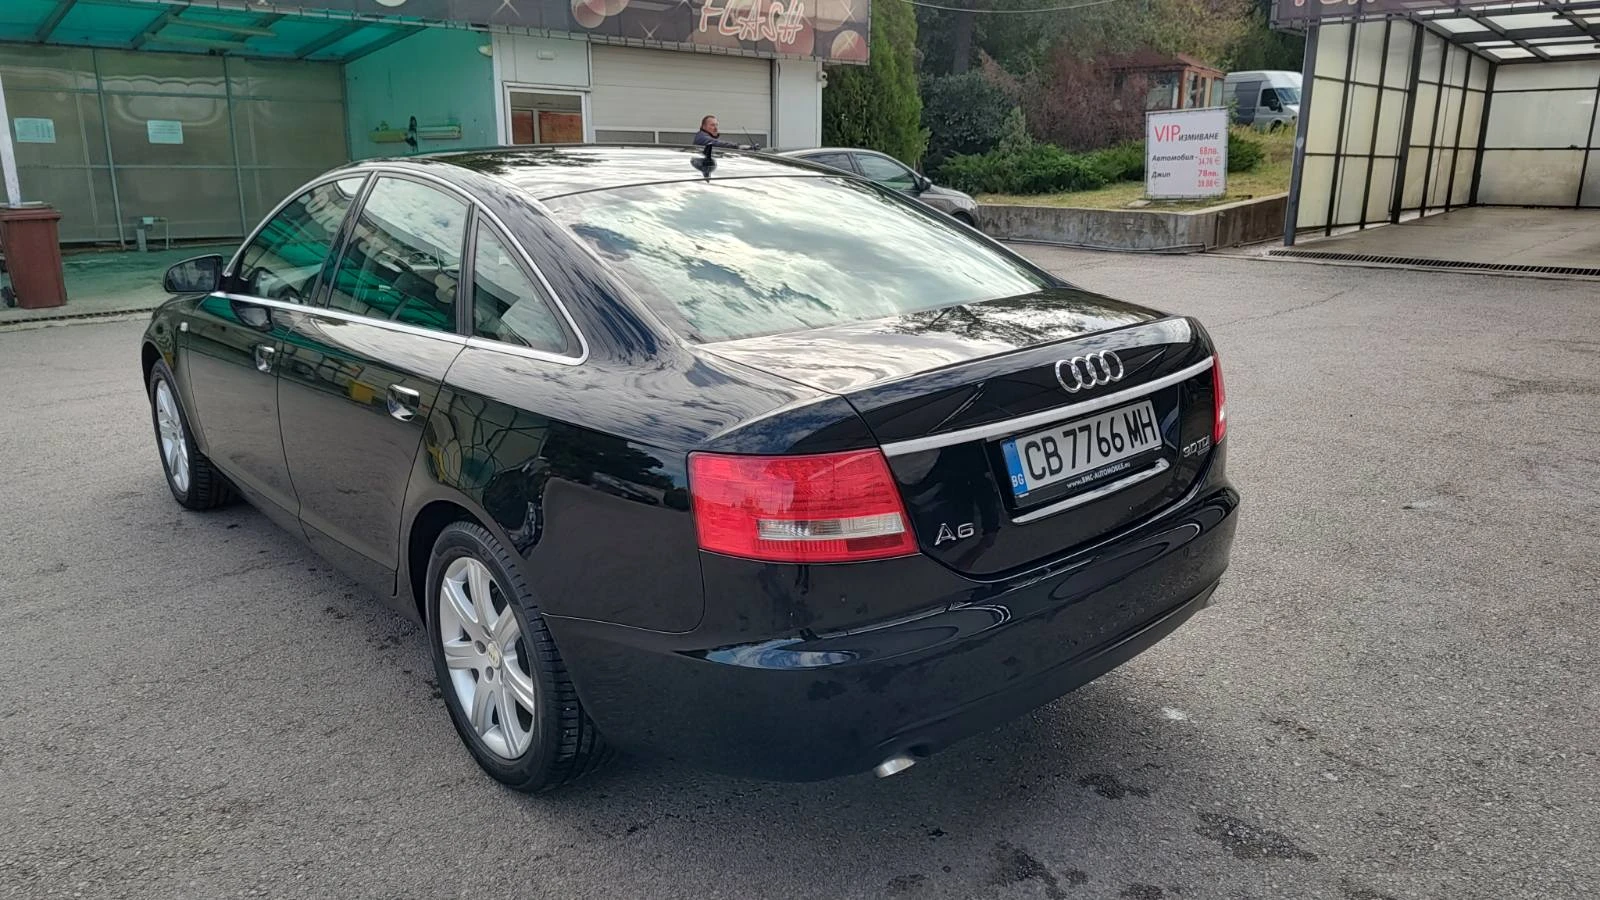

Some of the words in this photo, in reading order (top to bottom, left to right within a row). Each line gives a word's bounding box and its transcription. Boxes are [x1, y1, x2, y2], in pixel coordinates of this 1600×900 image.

[699, 0, 804, 45] FLASH
[1154, 124, 1181, 142] VIP
[1179, 133, 1219, 142] ИЗМИВАНЕ
[1151, 171, 1171, 179] Джип
[1024, 436, 1063, 481] CB
[1062, 416, 1125, 470] 7766
[1123, 406, 1157, 449] MH
[1011, 473, 1025, 488] BG
[934, 522, 975, 546] A6
